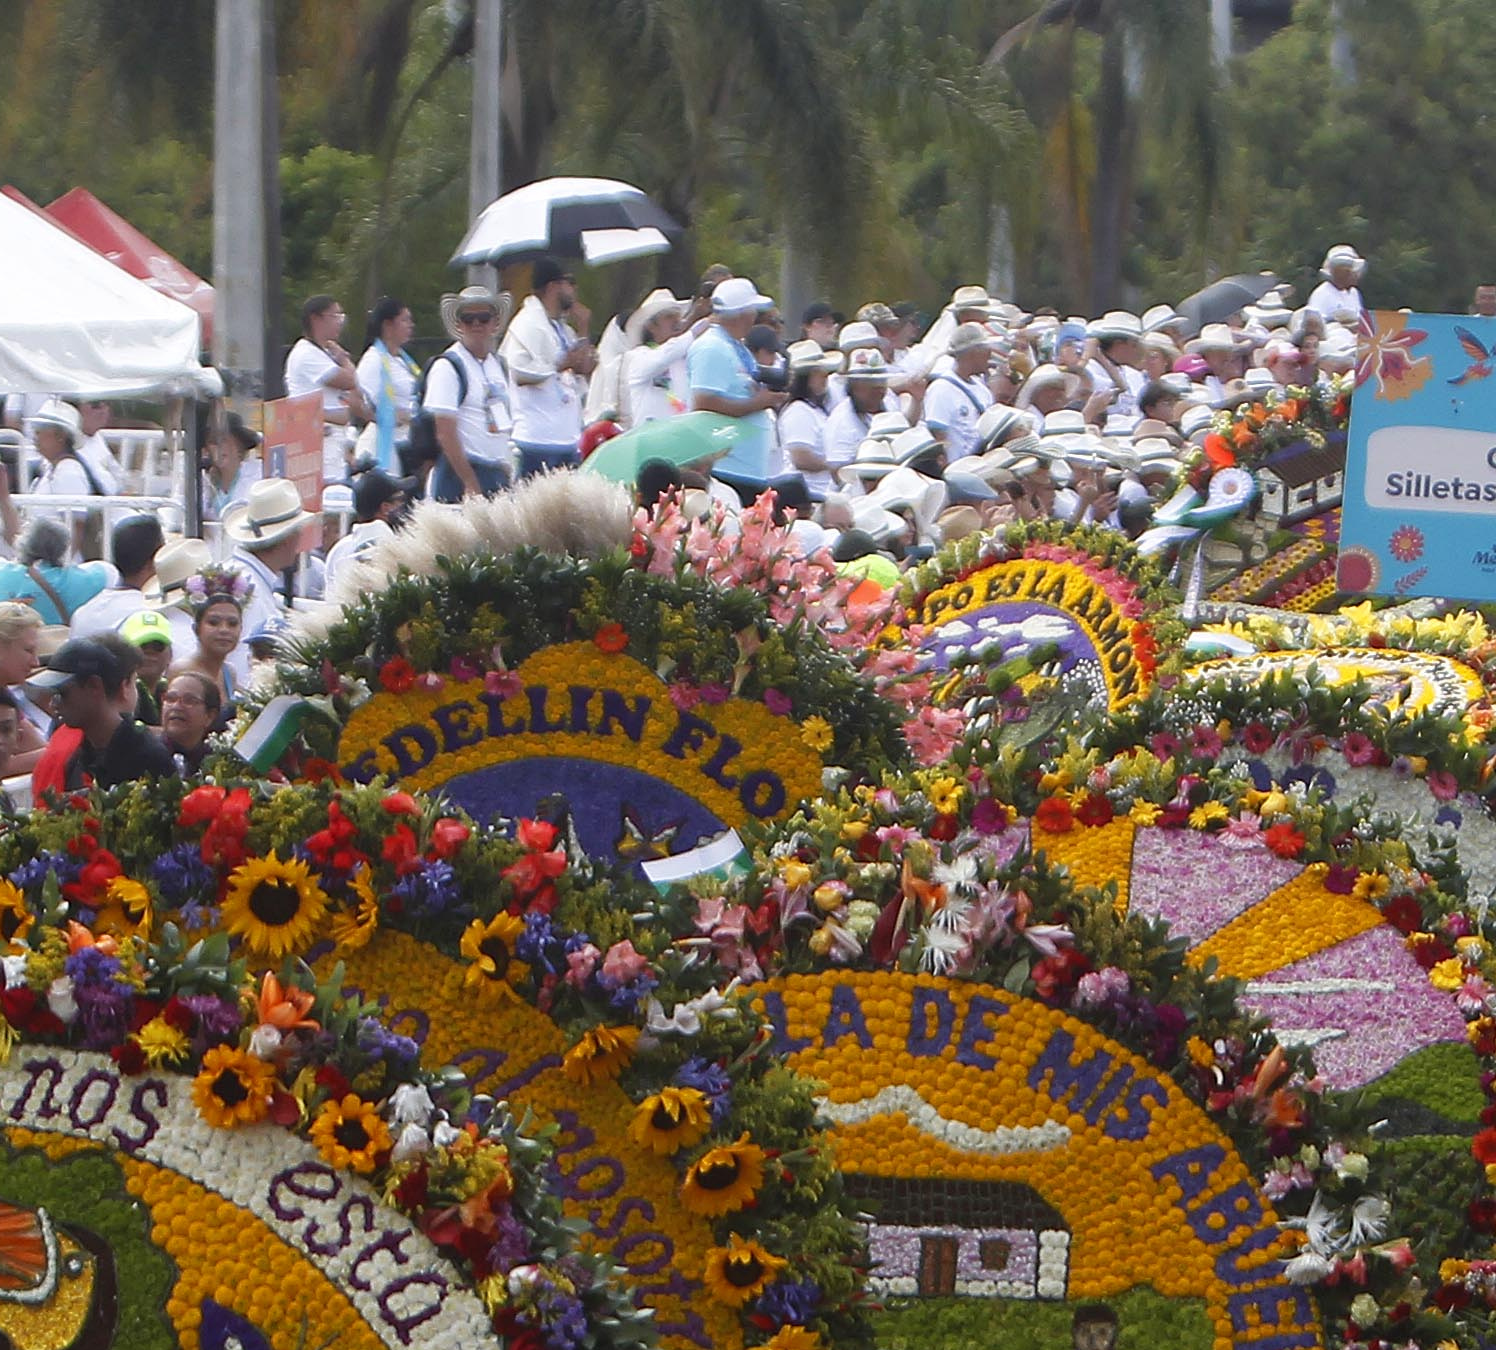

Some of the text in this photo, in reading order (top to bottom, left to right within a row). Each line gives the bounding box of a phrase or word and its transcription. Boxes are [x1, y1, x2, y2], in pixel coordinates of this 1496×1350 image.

[985, 570, 1027, 601] ES
[910, 987, 1012, 1070] DE
[1026, 1029, 1169, 1141] MIS
[265, 1159, 462, 1345] esta
